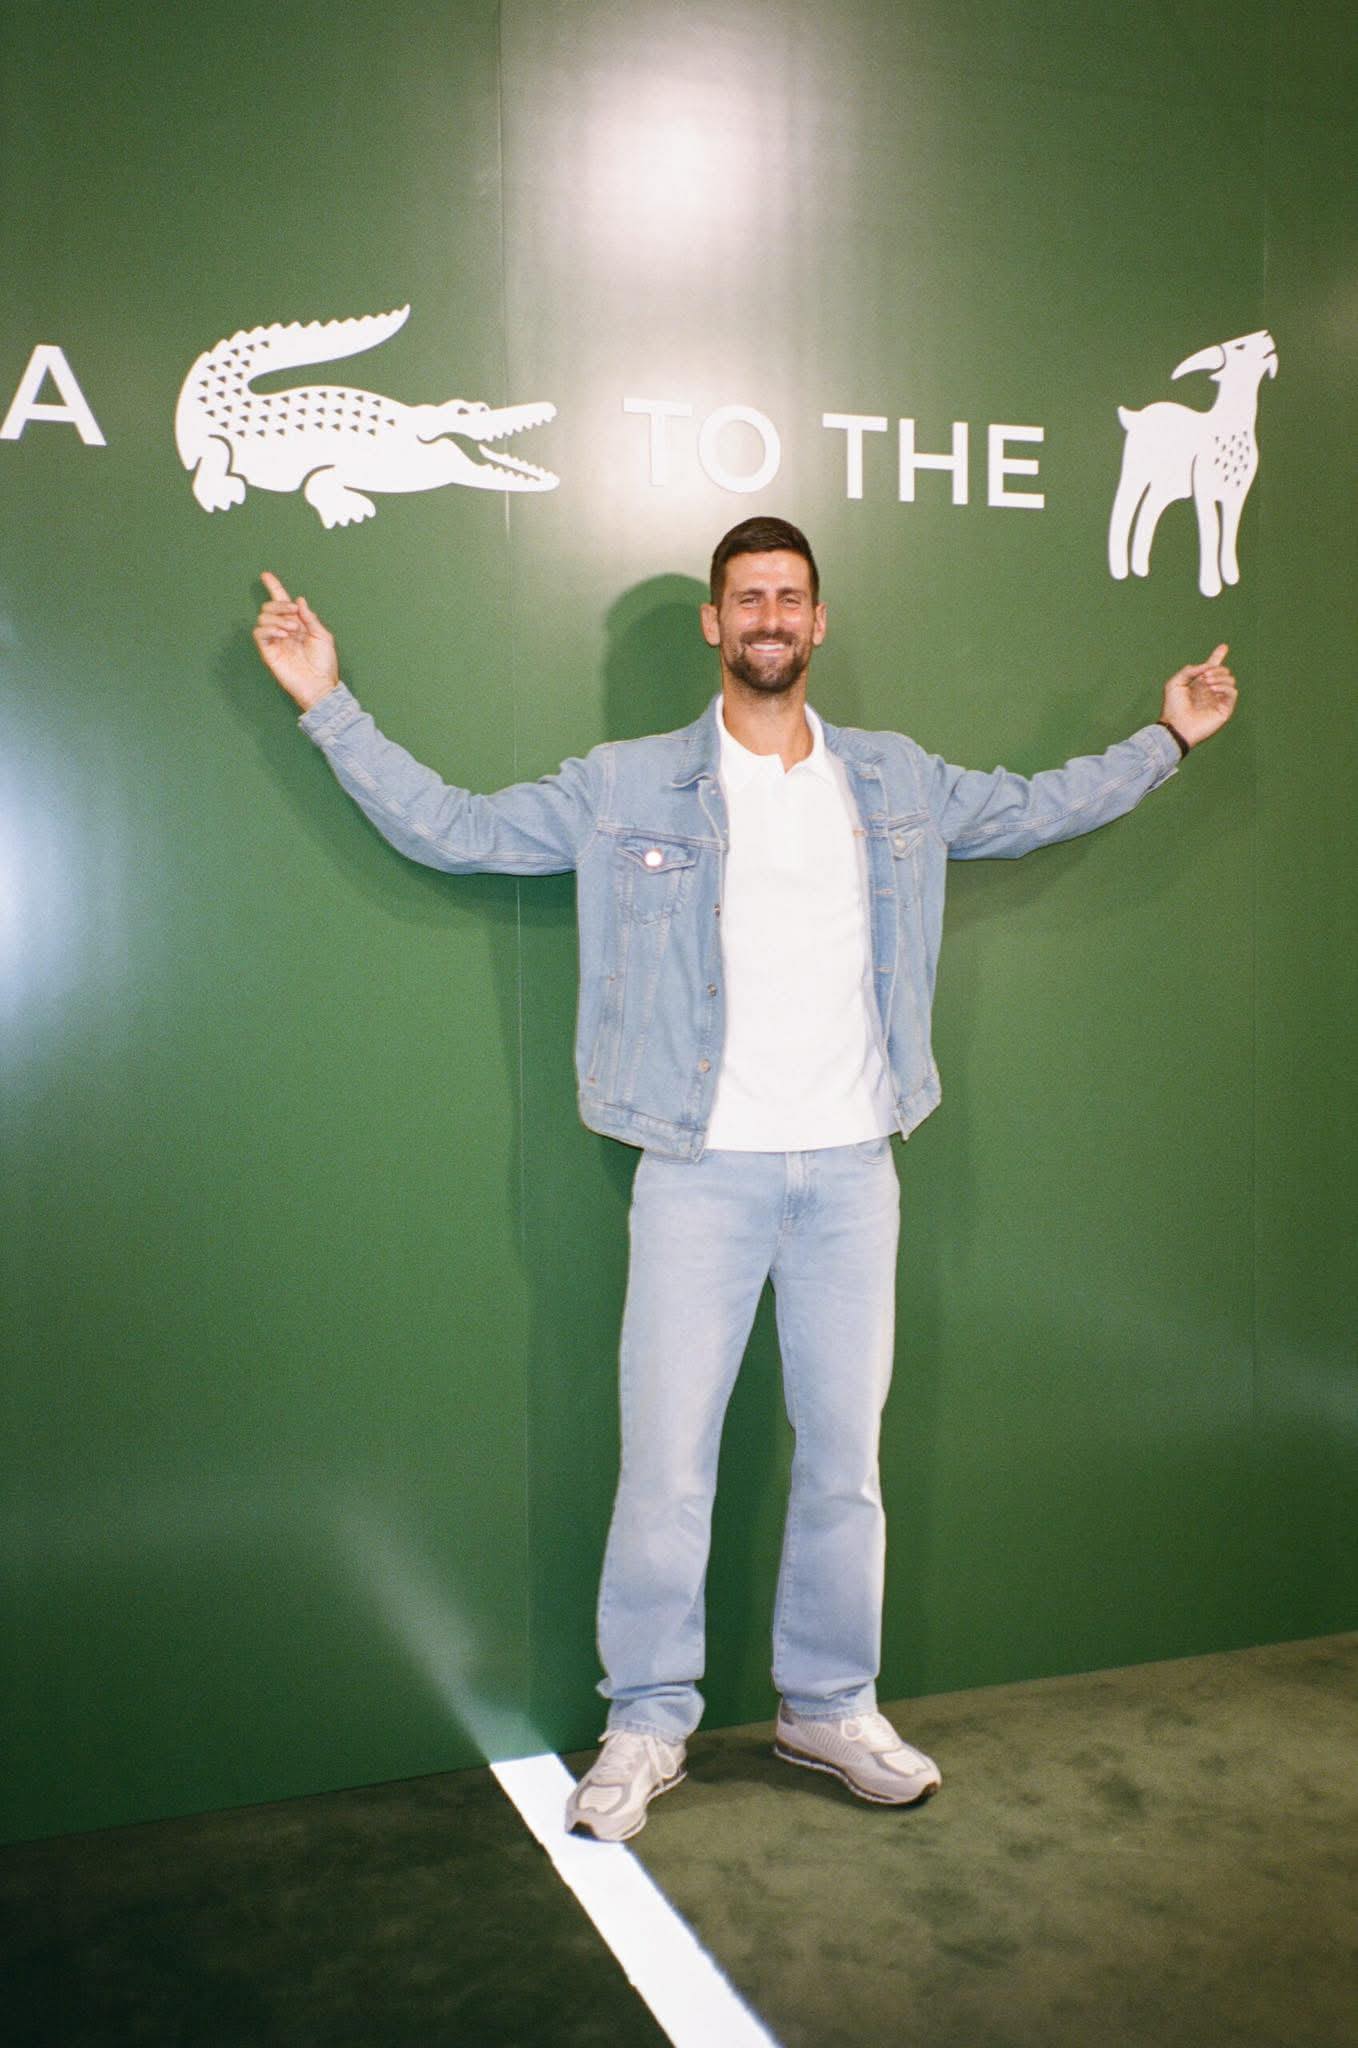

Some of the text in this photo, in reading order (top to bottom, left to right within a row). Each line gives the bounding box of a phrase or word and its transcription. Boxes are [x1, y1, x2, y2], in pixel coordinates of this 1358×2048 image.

[0, 344, 1044, 508] A TO THE
